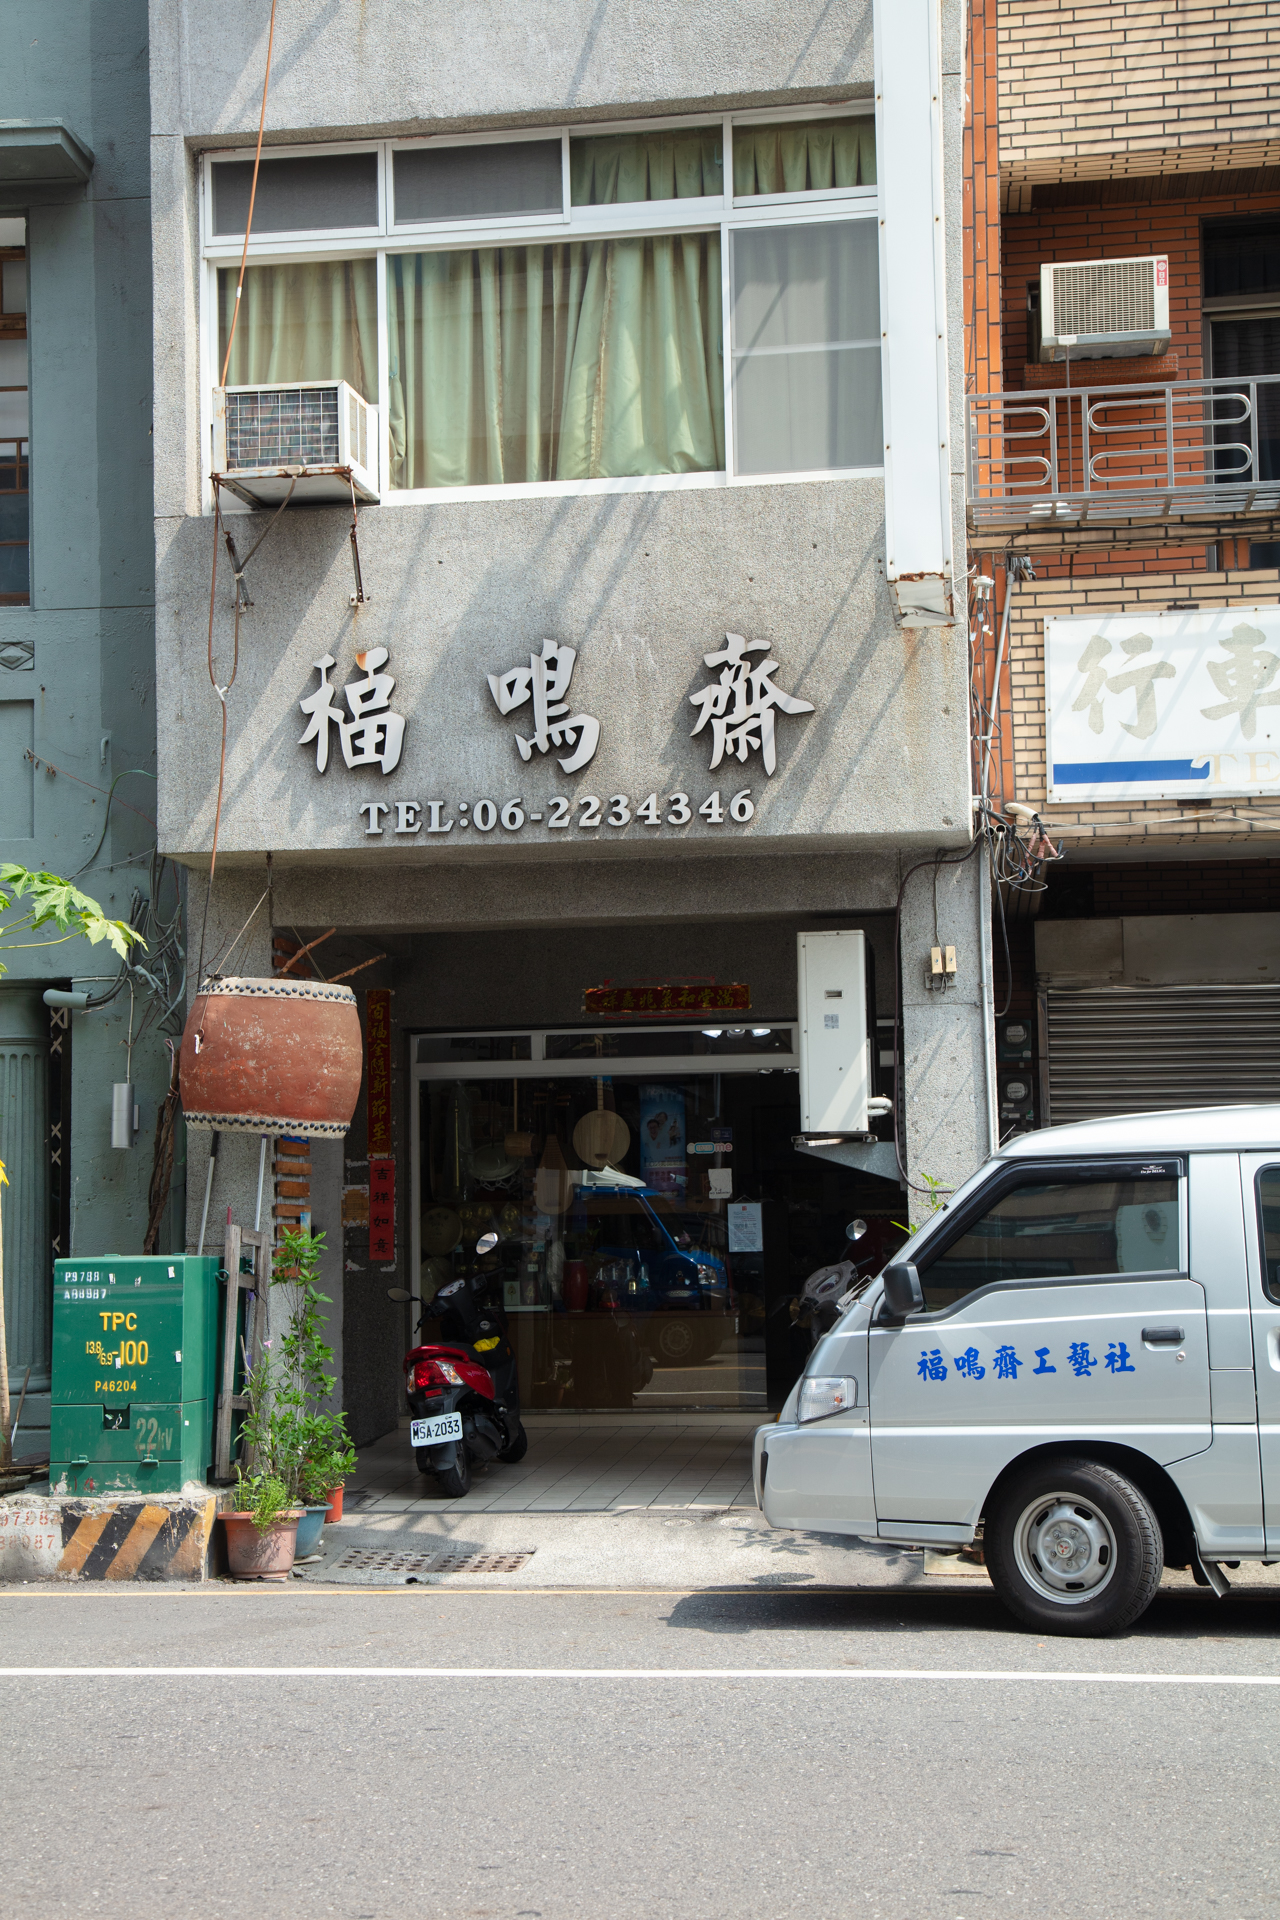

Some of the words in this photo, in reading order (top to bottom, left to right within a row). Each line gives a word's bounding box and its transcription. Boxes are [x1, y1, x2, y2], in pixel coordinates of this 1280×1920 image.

[1158, 271, 1166, 286] 日立
[1071, 621, 1280, 742] 行車
[358, 788, 756, 836] TEL:06-2234346
[373, 1167, 391, 1253] 吉祥如意
[99, 1312, 138, 1331] TPC
[916, 1341, 1136, 1382] 福鳴齋工藝社
[95, 1380, 137, 1392] P46204
[412, 1419, 460, 1440] MSA-2033
